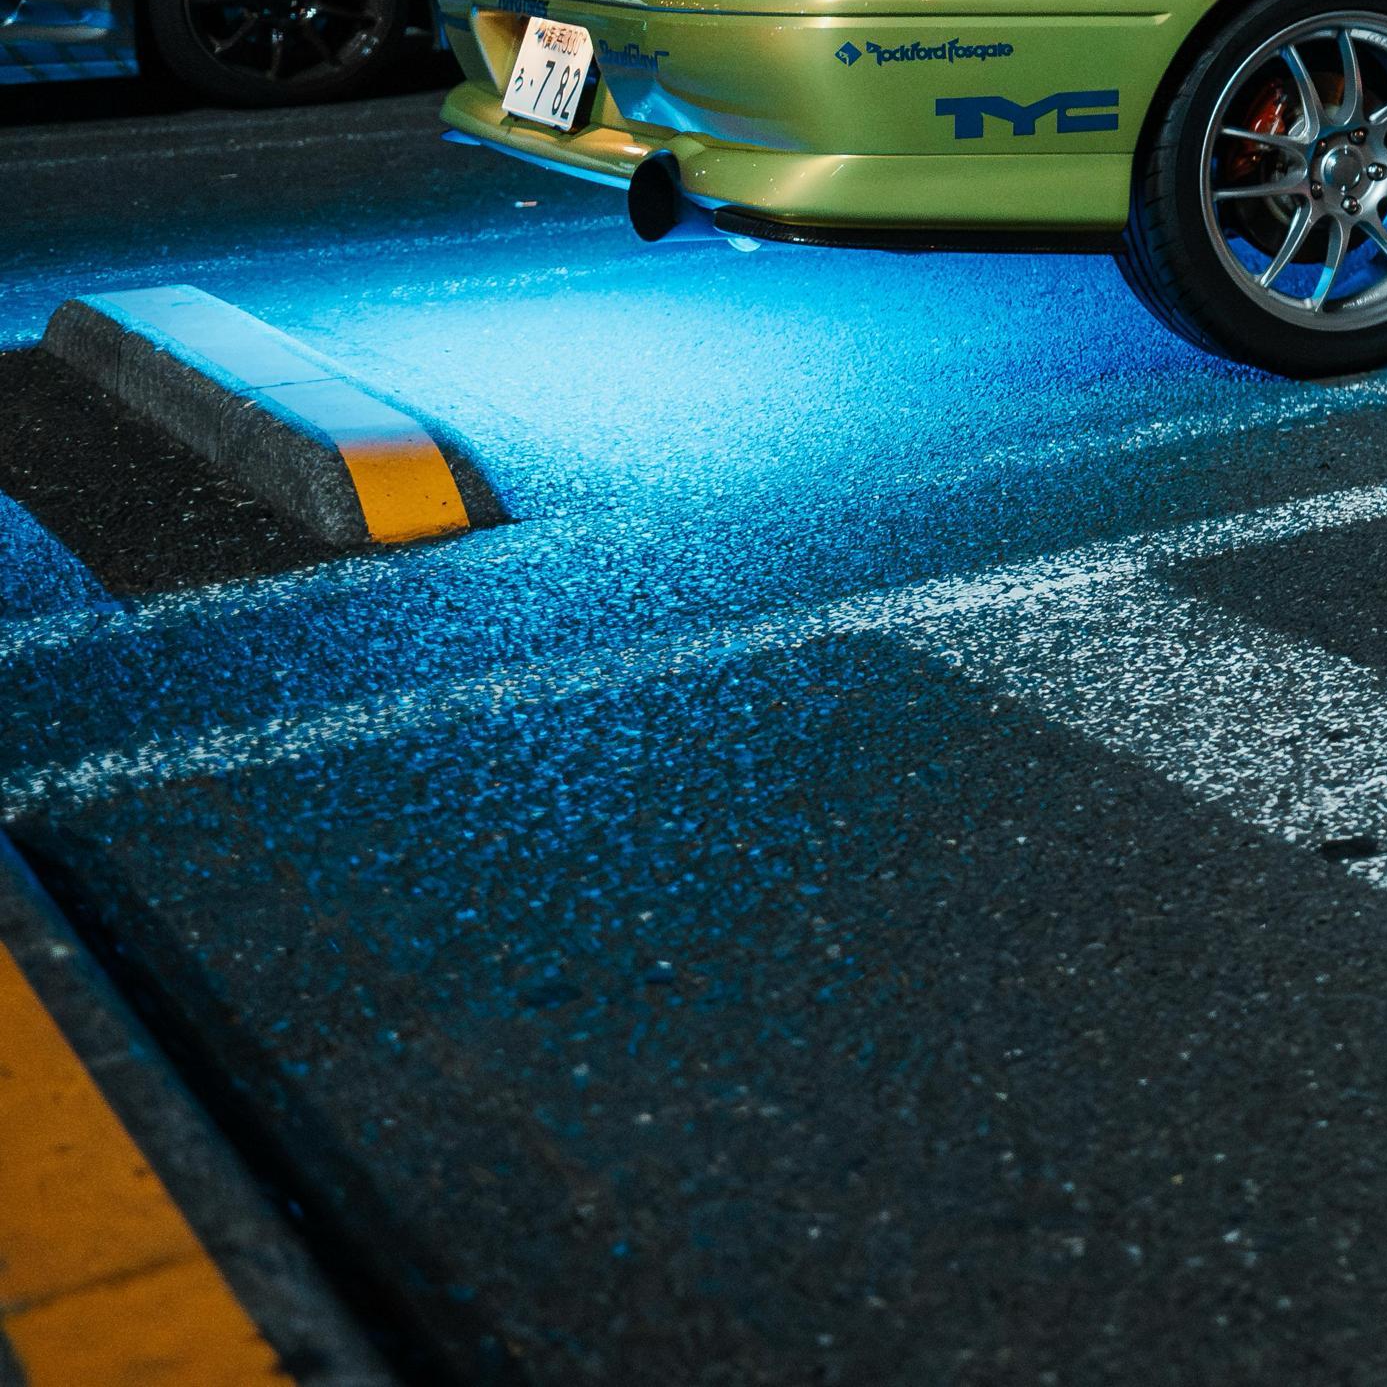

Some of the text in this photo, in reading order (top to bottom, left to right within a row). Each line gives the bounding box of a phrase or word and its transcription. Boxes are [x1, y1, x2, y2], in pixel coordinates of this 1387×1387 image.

[866, 37, 1014, 67] Rockford Fosgate
[935, 89, 1120, 140] TYC
